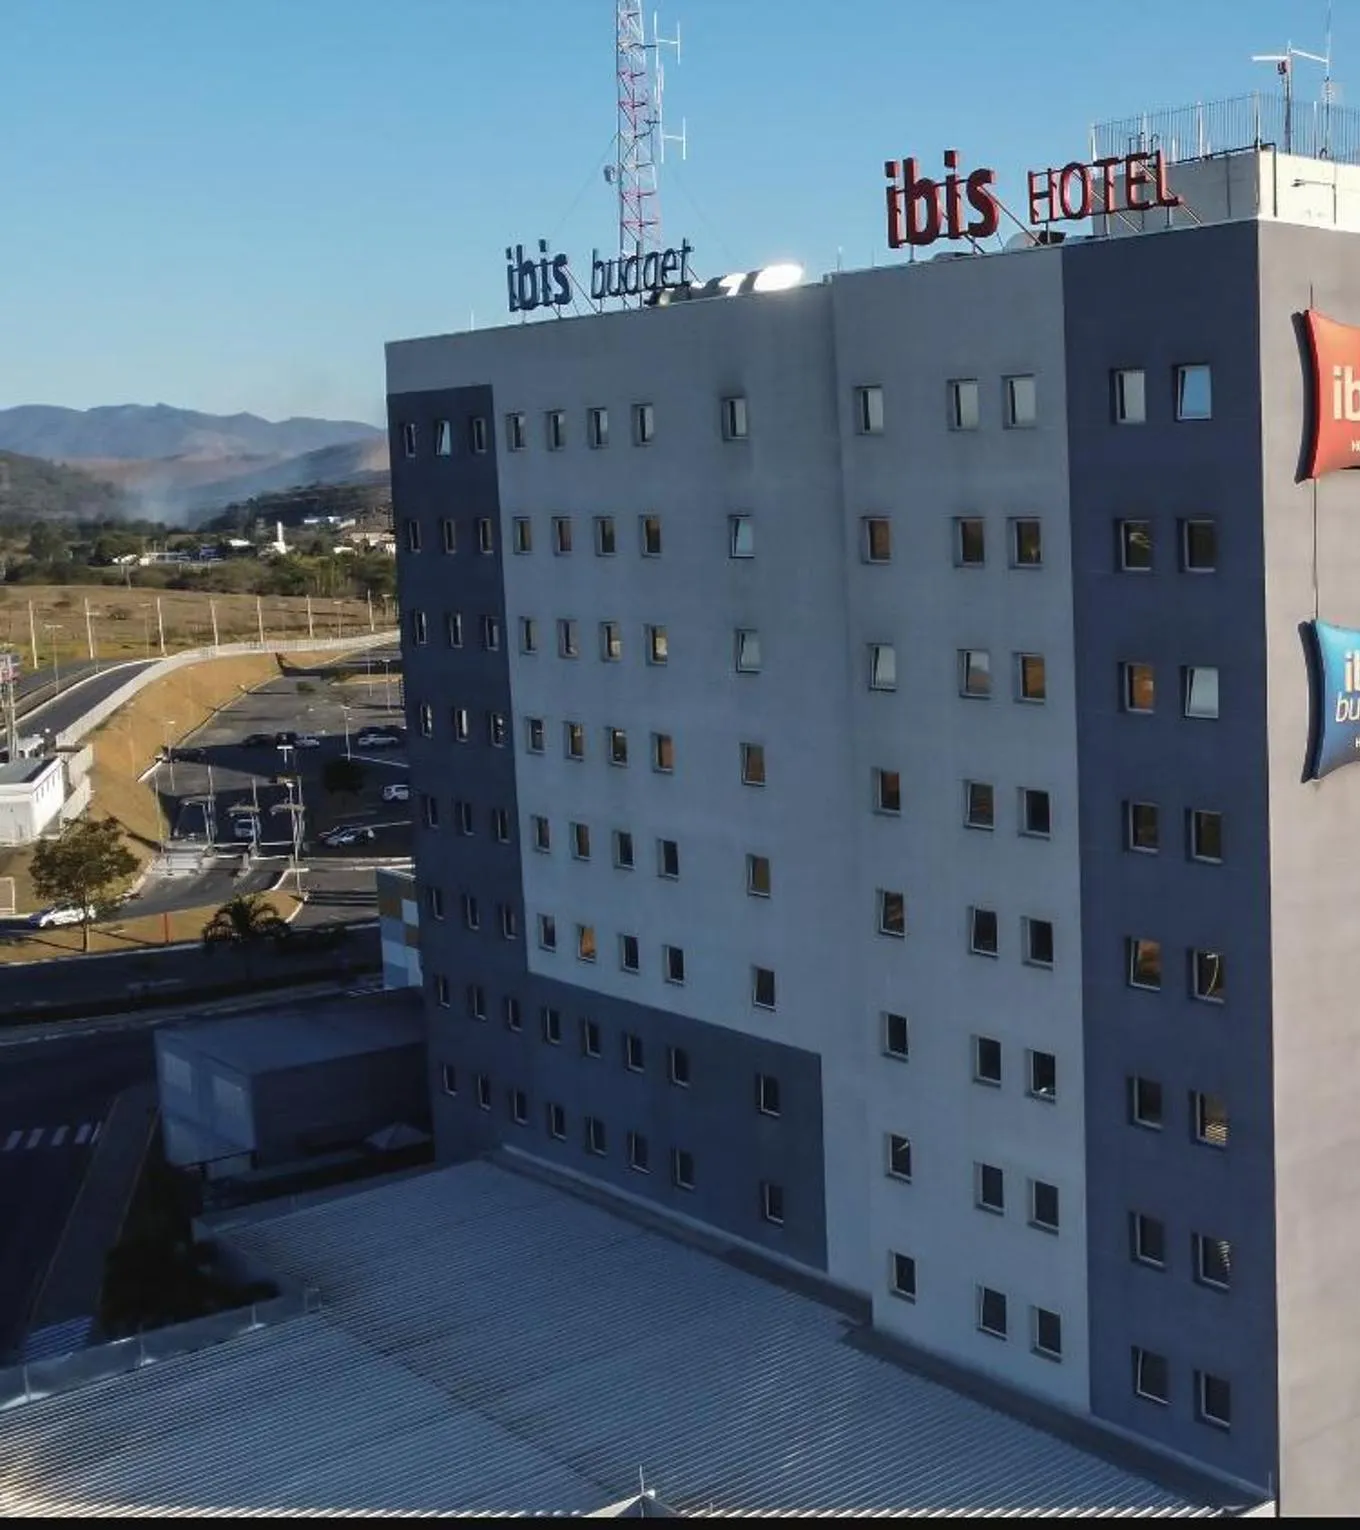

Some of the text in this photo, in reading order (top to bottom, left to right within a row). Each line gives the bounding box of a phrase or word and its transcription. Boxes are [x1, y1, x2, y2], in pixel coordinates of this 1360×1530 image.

[884, 150, 1179, 247] ibis HOTEL
[506, 238, 694, 312] ibis budget
